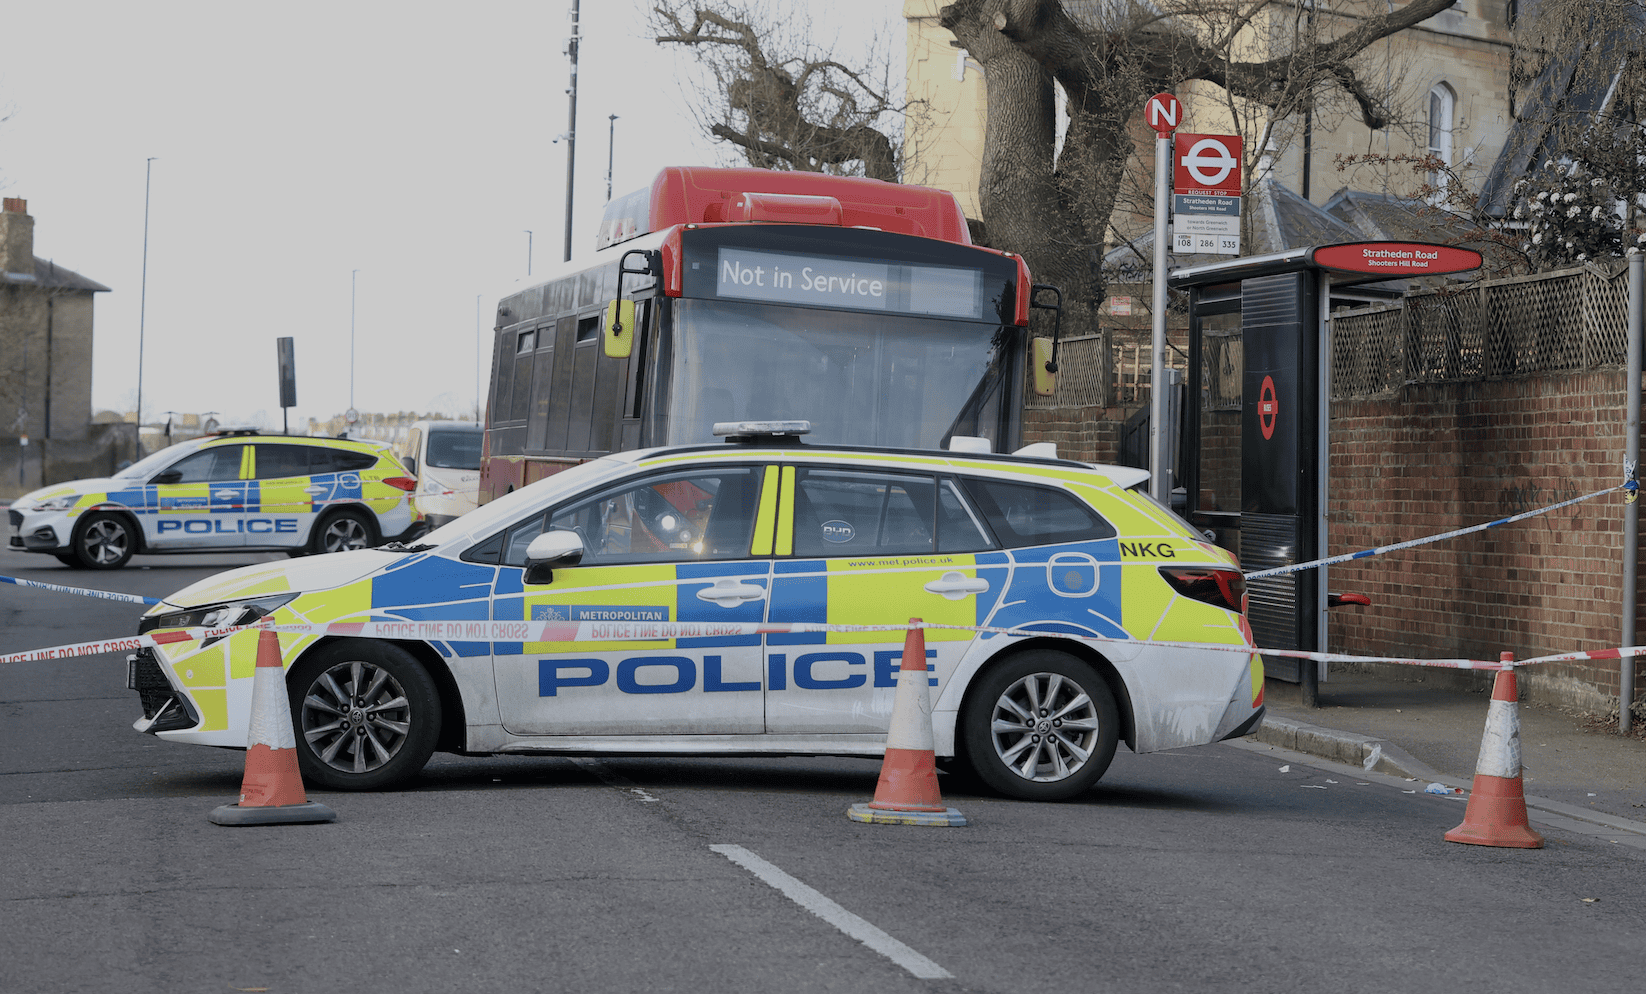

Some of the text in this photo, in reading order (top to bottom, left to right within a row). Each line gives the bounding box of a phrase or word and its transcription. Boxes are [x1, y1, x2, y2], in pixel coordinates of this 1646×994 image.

[1151, 98, 1177, 126] N
[1183, 197, 1217, 205] Stratheden
[1177, 239, 1236, 248] 108 286 335
[1362, 248, 1438, 260] Stratheden Road
[1368, 259, 1398, 267] Shooters
[1411, 260, 1429, 268] Road
[722, 260, 883, 297] Not in Service
[157, 518, 299, 534] POLICE
[1119, 542, 1176, 558] NKG
[847, 556, 954, 567] www.met.police.uk
[579, 610, 662, 621] METROPOLITAN
[538, 649, 939, 697] POLICE
